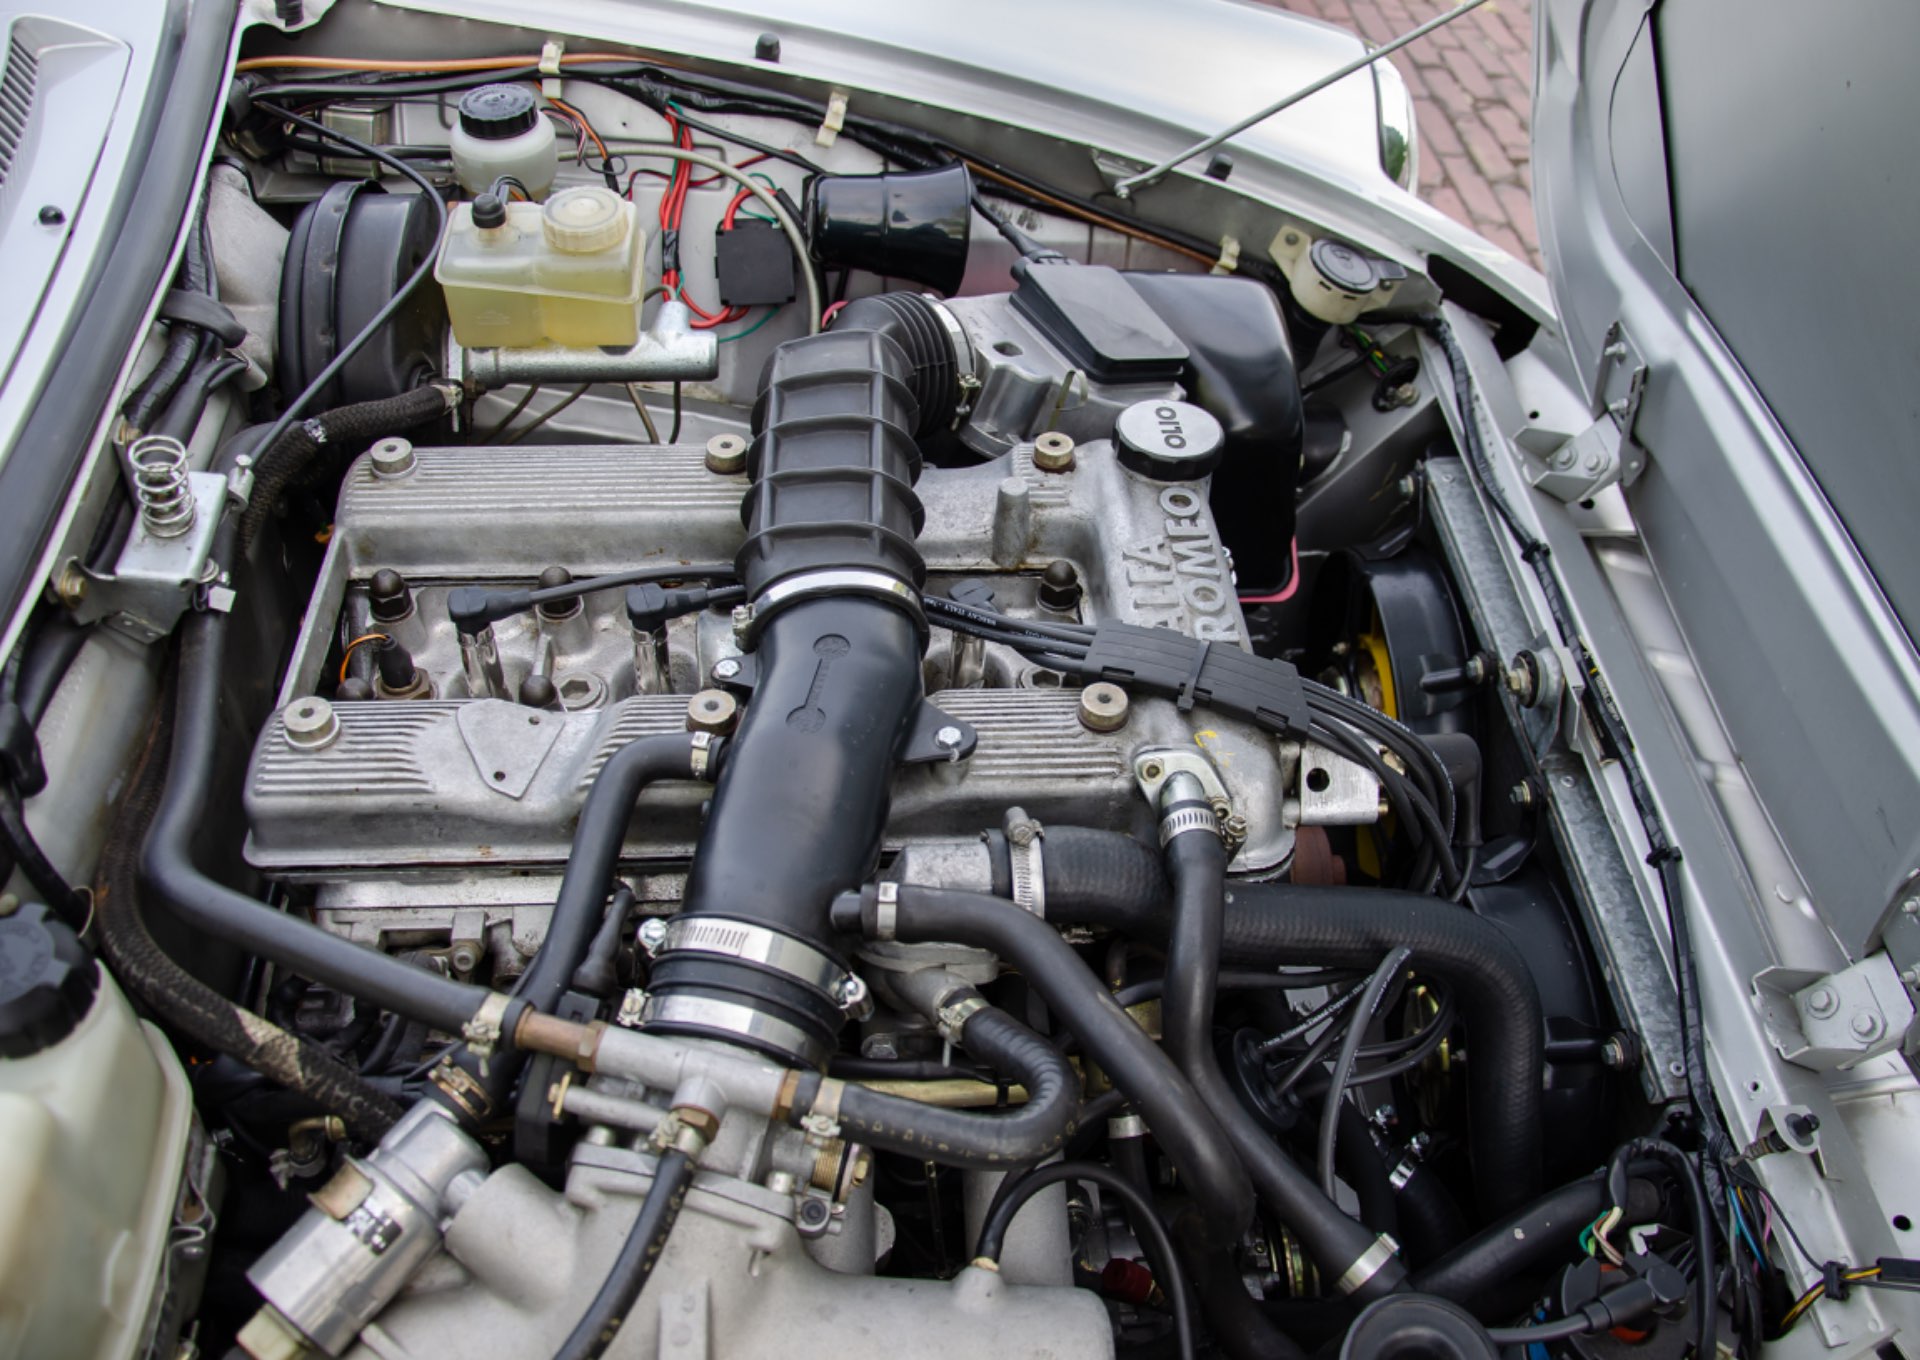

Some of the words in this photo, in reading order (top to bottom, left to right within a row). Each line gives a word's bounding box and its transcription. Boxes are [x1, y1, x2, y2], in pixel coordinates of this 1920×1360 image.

[1155, 406, 1187, 449] OLIO
[1159, 486, 1241, 643] ROMEO
[944, 603, 966, 615] ITALY
